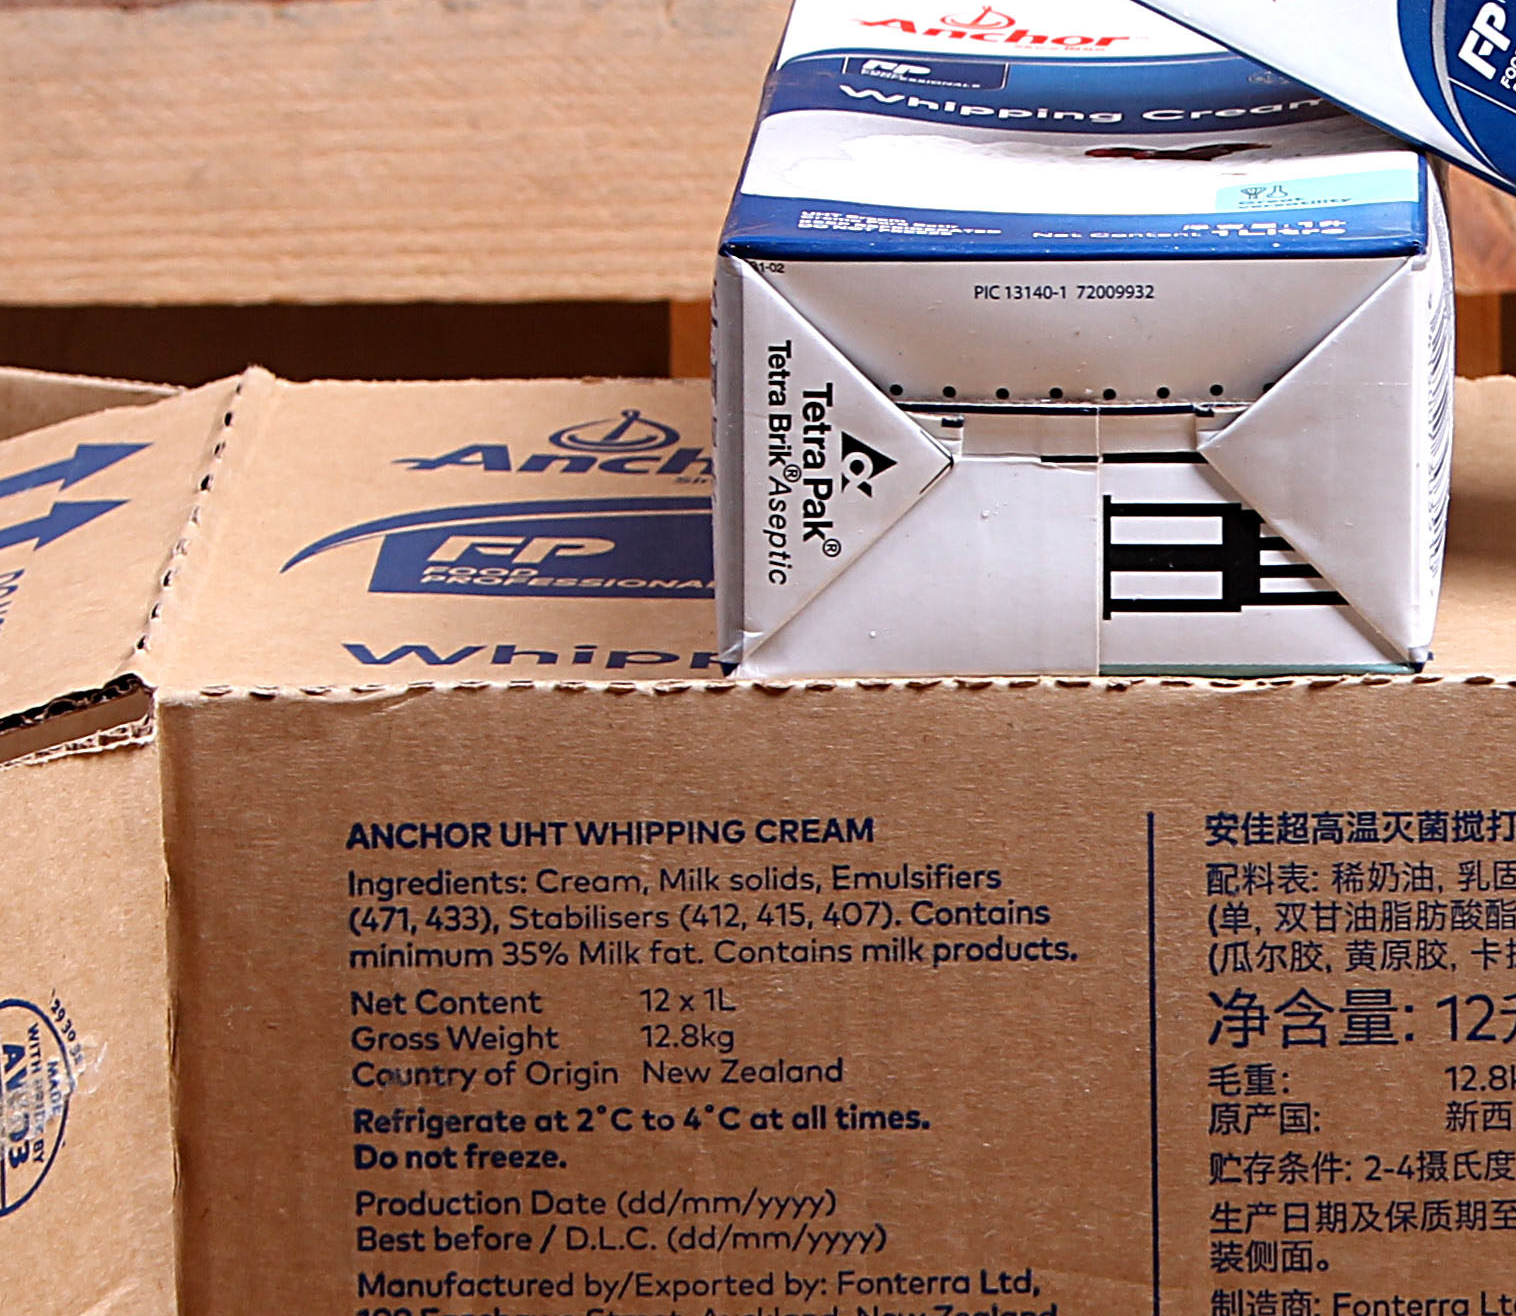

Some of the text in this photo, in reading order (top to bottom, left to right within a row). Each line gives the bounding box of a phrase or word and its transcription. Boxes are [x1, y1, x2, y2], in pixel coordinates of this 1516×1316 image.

[851, 17, 1130, 48] Anchor
[1458, 1, 1511, 80] FP
[839, 85, 1122, 123] Whipping
[973, 284, 1155, 300] PIC 13140-1 72009932
[802, 382, 833, 470] Tetra
[763, 340, 793, 586] Tetra Aseptic
[427, 535, 617, 565] FP
[421, 565, 540, 578] FOOD
[346, 817, 873, 849] ANCHOR UHT WHIPPING CREAM
[349, 863, 1002, 901] Ingredients: Cream, Milk solids, Emulsifiers
[1206, 862, 1318, 896] 配料表:
[1332, 861, 1443, 894] 稀奶油,
[349, 899, 1051, 936] (471, 433), Stabilisers (412, 415, 407). Contains
[1208, 902, 1260, 937] (单,
[350, 935, 1078, 968] minimum 35% Milk fat. Contains milk products.
[1209, 939, 1456, 976] (瓜尔胶, 黄原胶,
[351, 988, 736, 1015] Net Content 12 x 1L
[1208, 987, 1414, 1049] 净含量:
[352, 1024, 734, 1055] Gross Weight 12.8kg
[47, 1060, 62, 1116] MADE
[352, 1057, 843, 1092] Country of Origin New Zealand
[1208, 1063, 1289, 1096] 毛重:
[28, 1022, 45, 1163] WITH BY
[354, 1104, 930, 1138] Refrigerate at 2°C to 4°C at all times.
[1209, 1103, 1320, 1135] 原产国:
[354, 1143, 566, 1169] Do not freeze.
[1210, 1151, 1351, 1185] 贮存条件:
[356, 1188, 836, 1219] Production Date (dd/mm/yyyy)
[358, 1223, 886, 1254] Best before / D.L.C. (dd/mm/yyyy)
[1211, 1241, 1328, 1273] 装侧面。
[358, 1268, 1040, 1303] Manufactured by/Exported by: Fonterra Ltd,
[1334, 1292, 1468, 1316] Fonterra
